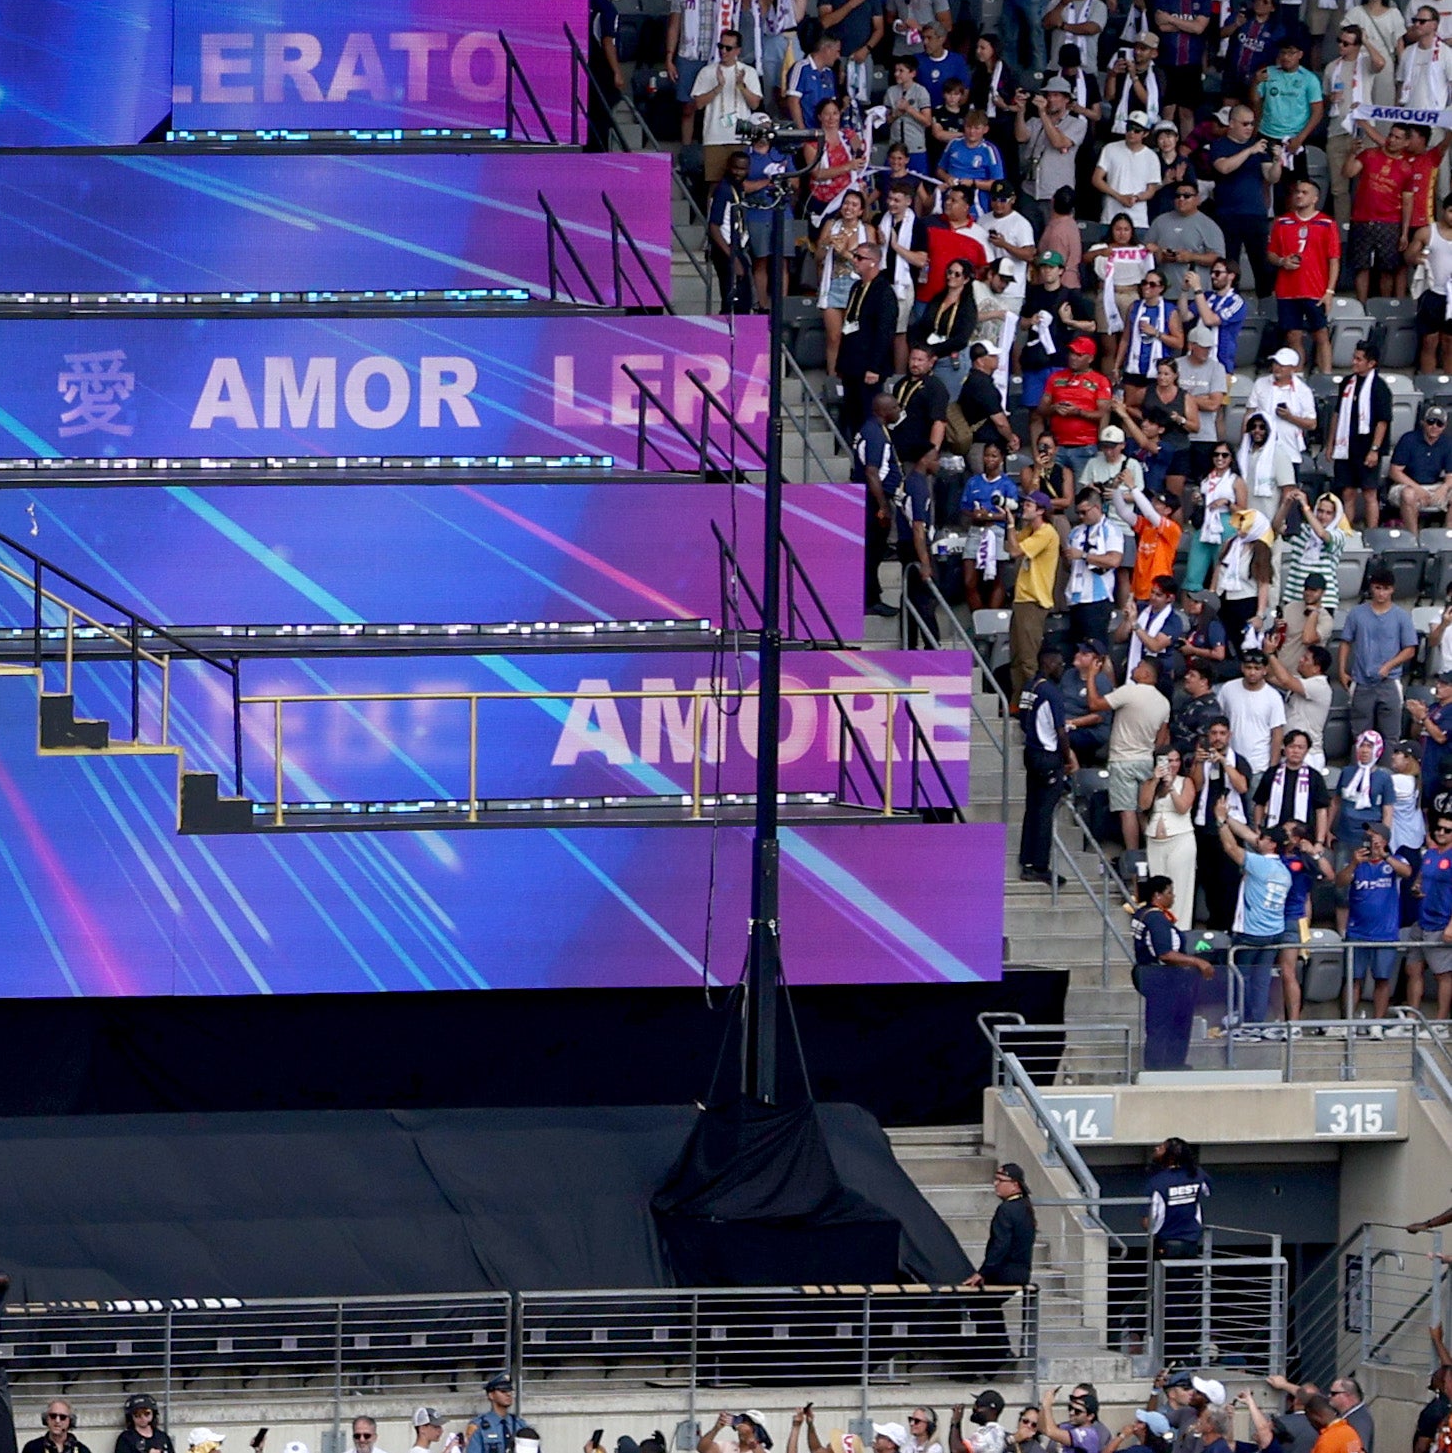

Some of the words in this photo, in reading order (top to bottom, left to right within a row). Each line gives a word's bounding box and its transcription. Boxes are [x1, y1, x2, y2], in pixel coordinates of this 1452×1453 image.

[172, 31, 507, 105] ERATO
[56, 349, 137, 439] 愛
[189, 354, 483, 430] AMOR
[551, 675, 970, 767] AMORE
[1329, 1104, 1383, 1134] 315
[1168, 1184, 1200, 1198] BEST
